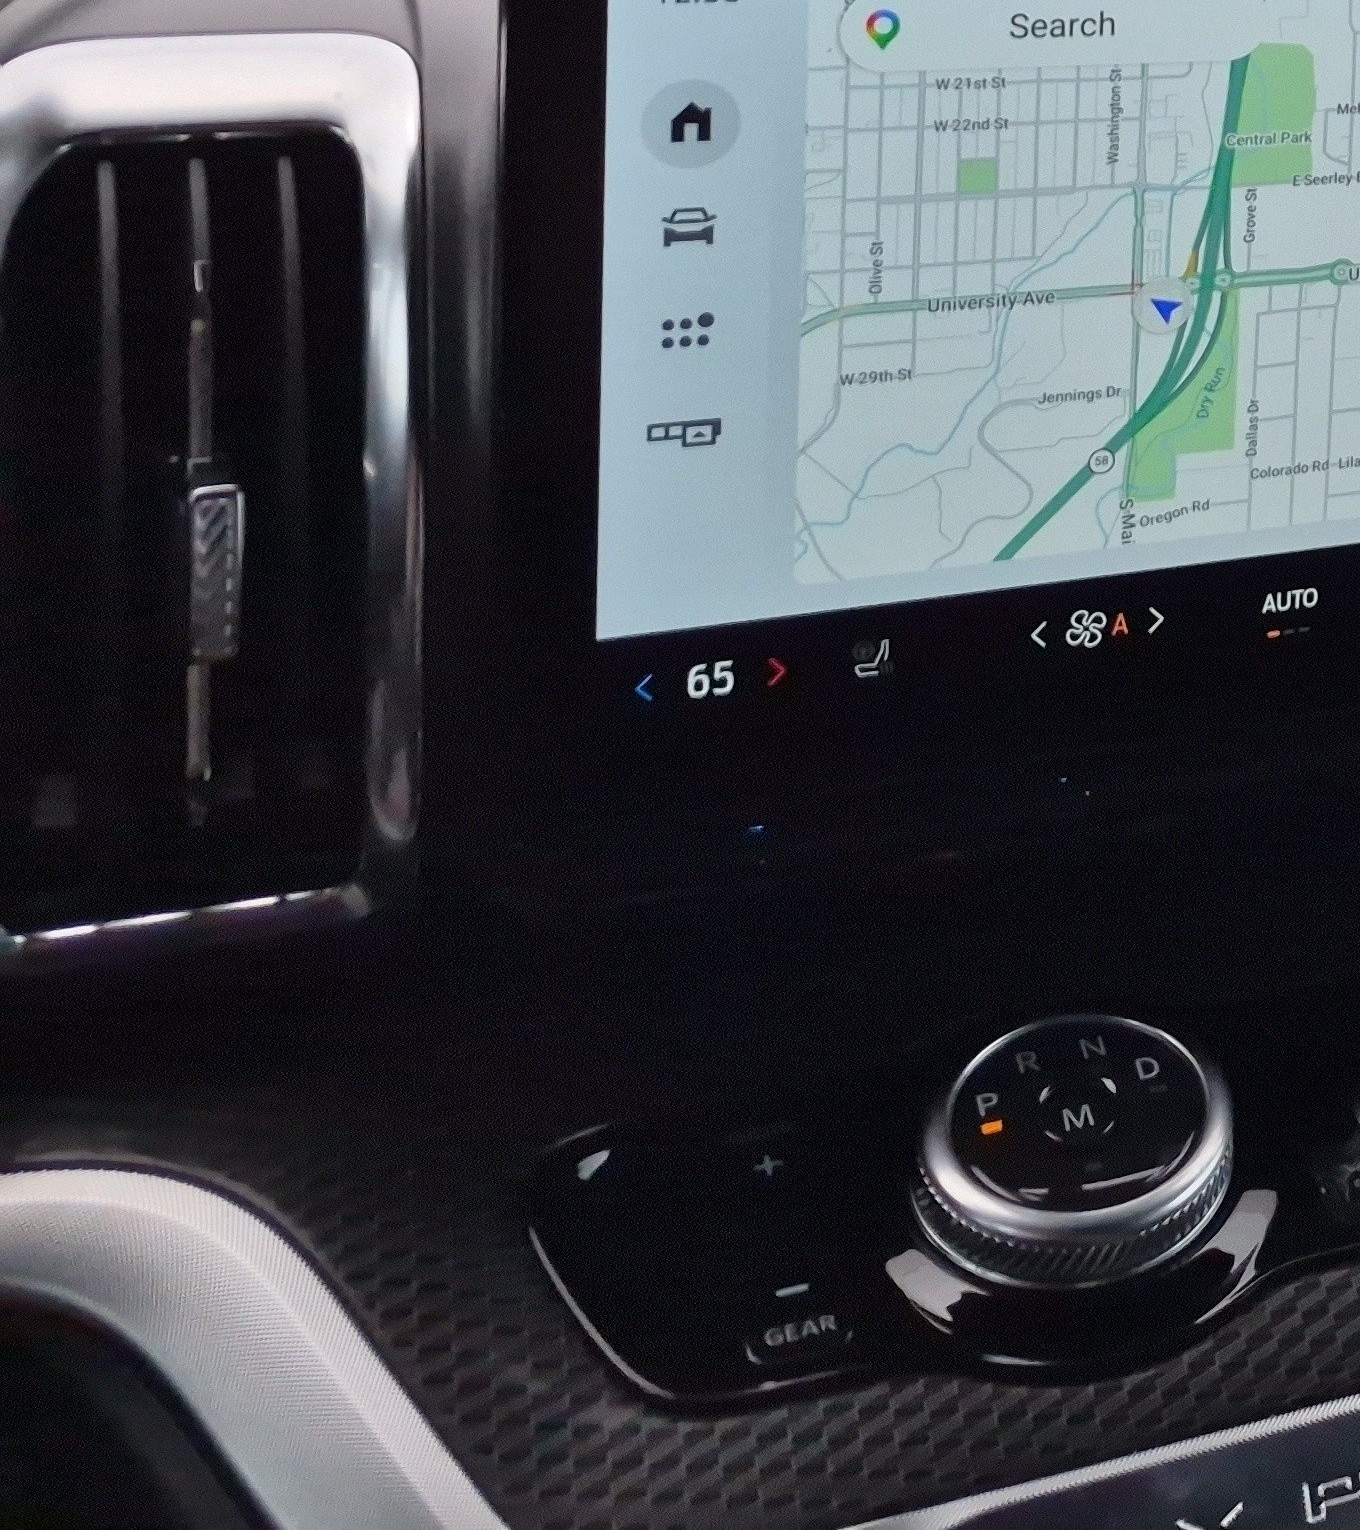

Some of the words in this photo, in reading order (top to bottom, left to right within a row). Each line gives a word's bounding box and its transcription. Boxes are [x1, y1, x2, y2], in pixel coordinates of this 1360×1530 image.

[1009, 10, 1117, 39] Search
[935, 77, 952, 91] W
[953, 76, 988, 90] 21st
[989, 75, 1007, 89] St
[1109, 68, 1123, 83] St
[933, 119, 950, 132] W
[951, 116, 991, 132] 22nd
[992, 116, 1010, 131] St
[1105, 85, 1125, 166] Washington
[1226, 131, 1276, 147] Central
[1278, 129, 1313, 145] Park
[1292, 174, 1302, 187] E
[1302, 172, 1354, 189] Seerley
[1244, 187, 1258, 202] St
[1242, 204, 1257, 244] Grove
[869, 240, 884, 258] St
[868, 258, 883, 295] Olive
[926, 291, 1018, 314] University
[1022, 291, 1057, 307] Ave
[839, 373, 855, 388] W
[856, 371, 895, 385] 29th
[897, 368, 913, 382] St
[1203, 367, 1227, 393] Run
[1036, 389, 1103, 407] Jennings
[1105, 385, 1123, 400] Dr
[1194, 395, 1214, 420] Dry
[1246, 397, 1260, 413] Dr
[1245, 415, 1259, 458] Dallas
[1094, 455, 1109, 468] 58
[1249, 463, 1310, 480] Colorado
[1310, 458, 1330, 473] Rd
[1118, 497, 1134, 512] S
[1139, 506, 1189, 528] Oregon
[1192, 499, 1211, 514] Rd
[1261, 587, 1320, 614] AUTO
[1111, 612, 1130, 638] A
[686, 660, 735, 700] 65
[974, 1091, 999, 1118] P
[1014, 1050, 1042, 1075] R
[1078, 1034, 1108, 1060] N
[1134, 1056, 1161, 1081] D
[1061, 1103, 1096, 1133] M
[763, 1314, 838, 1347] GEAR
